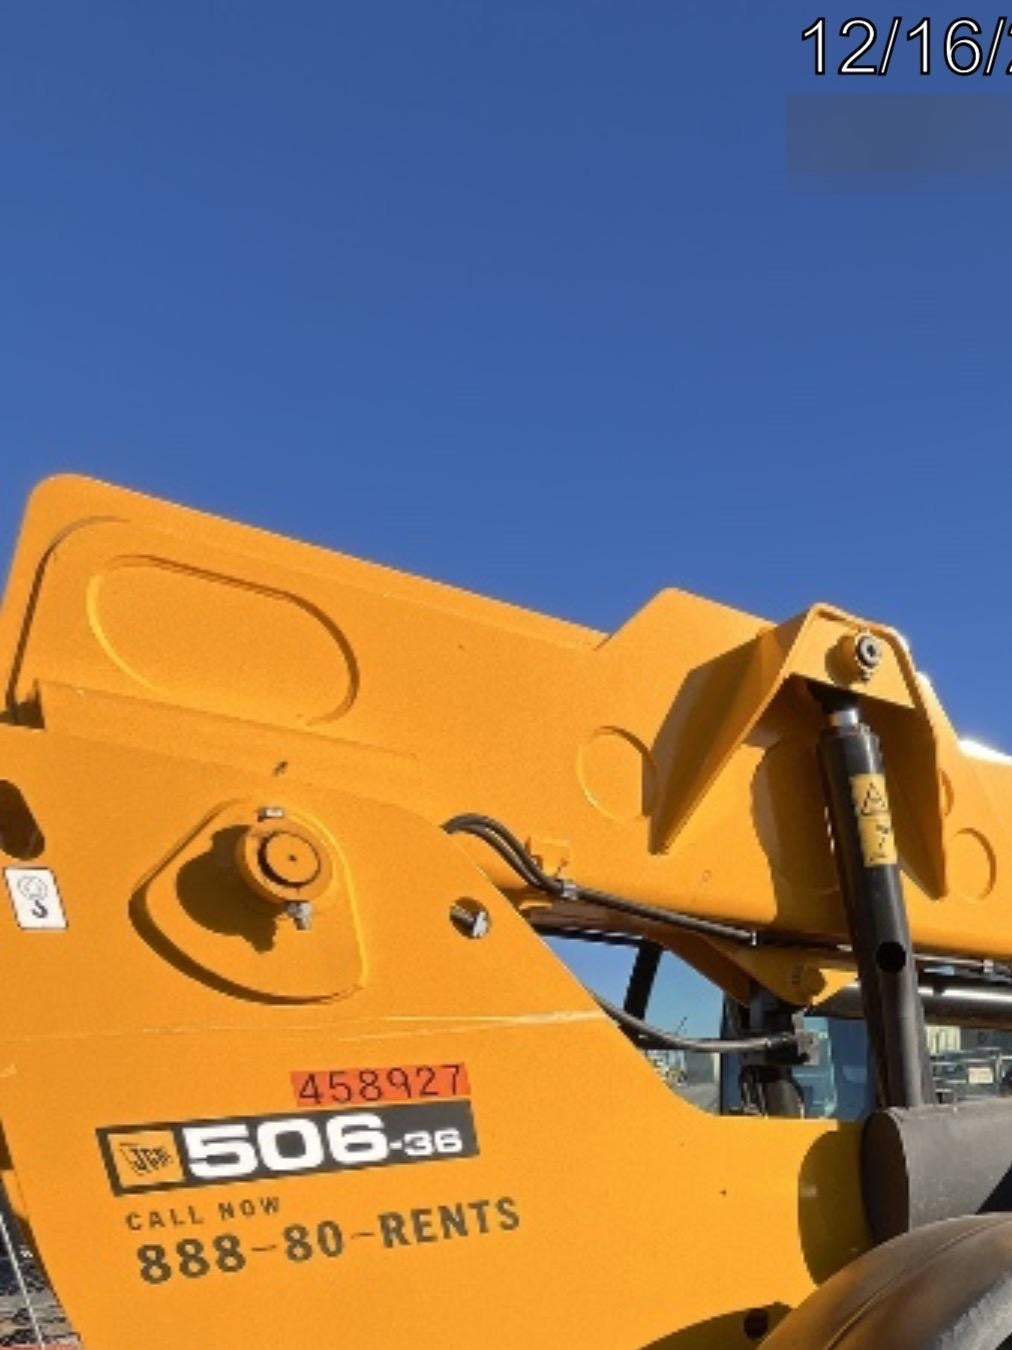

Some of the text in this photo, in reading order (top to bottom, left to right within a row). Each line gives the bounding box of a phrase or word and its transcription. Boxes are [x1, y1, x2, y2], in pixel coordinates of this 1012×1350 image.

[298, 1063, 461, 1105] 458927
[125, 1196, 281, 1231] CALL NOW
